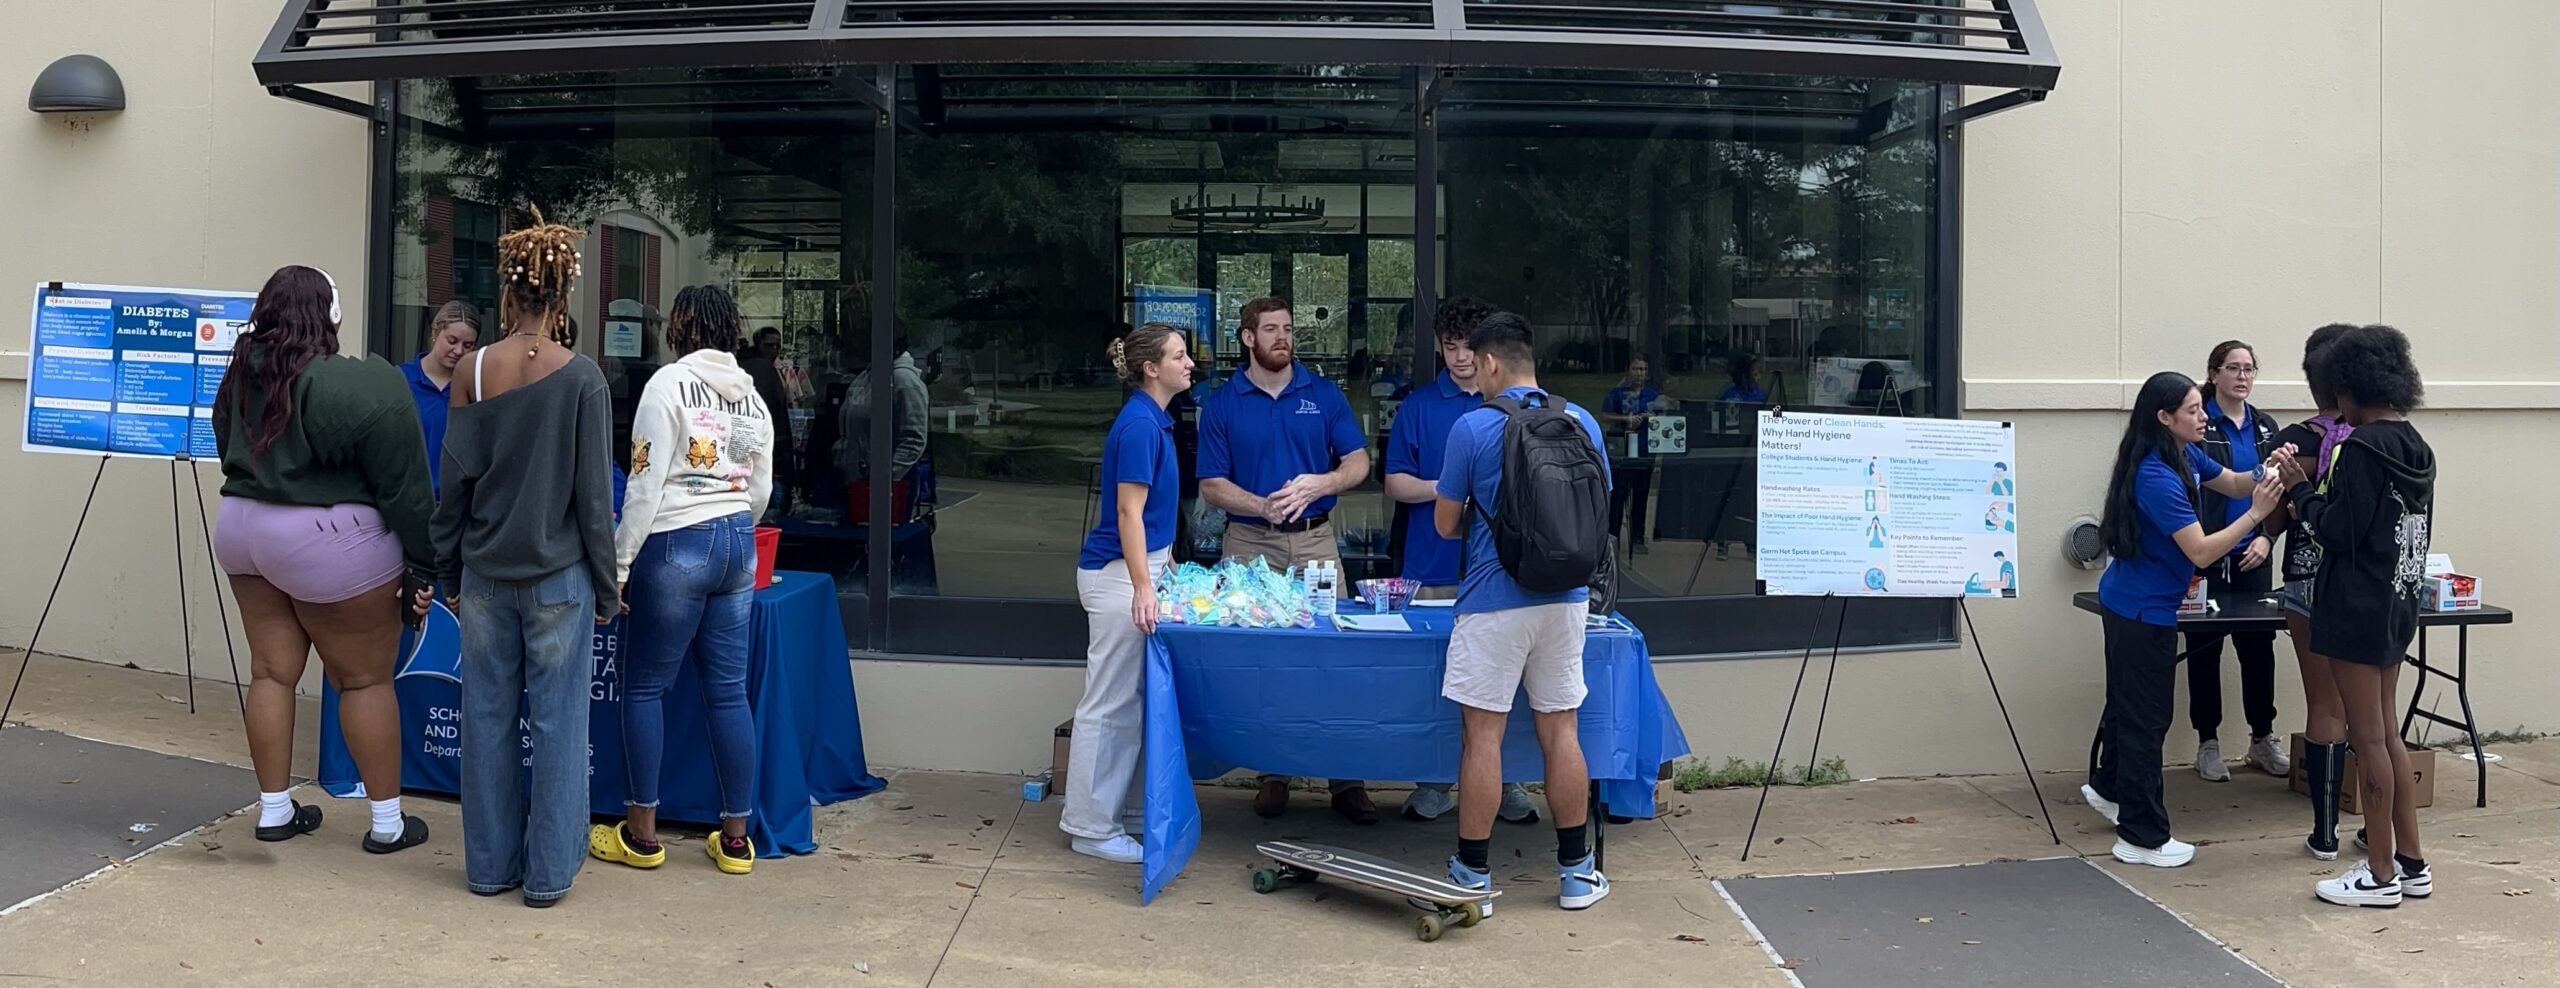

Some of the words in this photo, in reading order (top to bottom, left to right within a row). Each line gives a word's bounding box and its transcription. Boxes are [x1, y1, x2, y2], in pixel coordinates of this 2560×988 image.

[122, 306, 190, 318] DIABETES
[116, 328, 148, 336] Amelia
[150, 328, 158, 336] &
[160, 329, 193, 338] Morgan
[679, 381, 712, 408] LOS
[1762, 415, 1780, 424] The
[1782, 416, 1812, 426] Power
[1814, 417, 1822, 426] of
[1824, 418, 1852, 427] Clean
[1762, 428, 1783, 439] Why
[1786, 430, 1810, 438] Hand
[1812, 430, 1852, 441] Hygiene
[1762, 440, 1802, 450] Matters!
[1785, 454, 1812, 462] Students
[1760, 484, 1801, 493] Handwashing
[1774, 512, 1796, 520] Impact
[424, 724, 458, 739] AND
